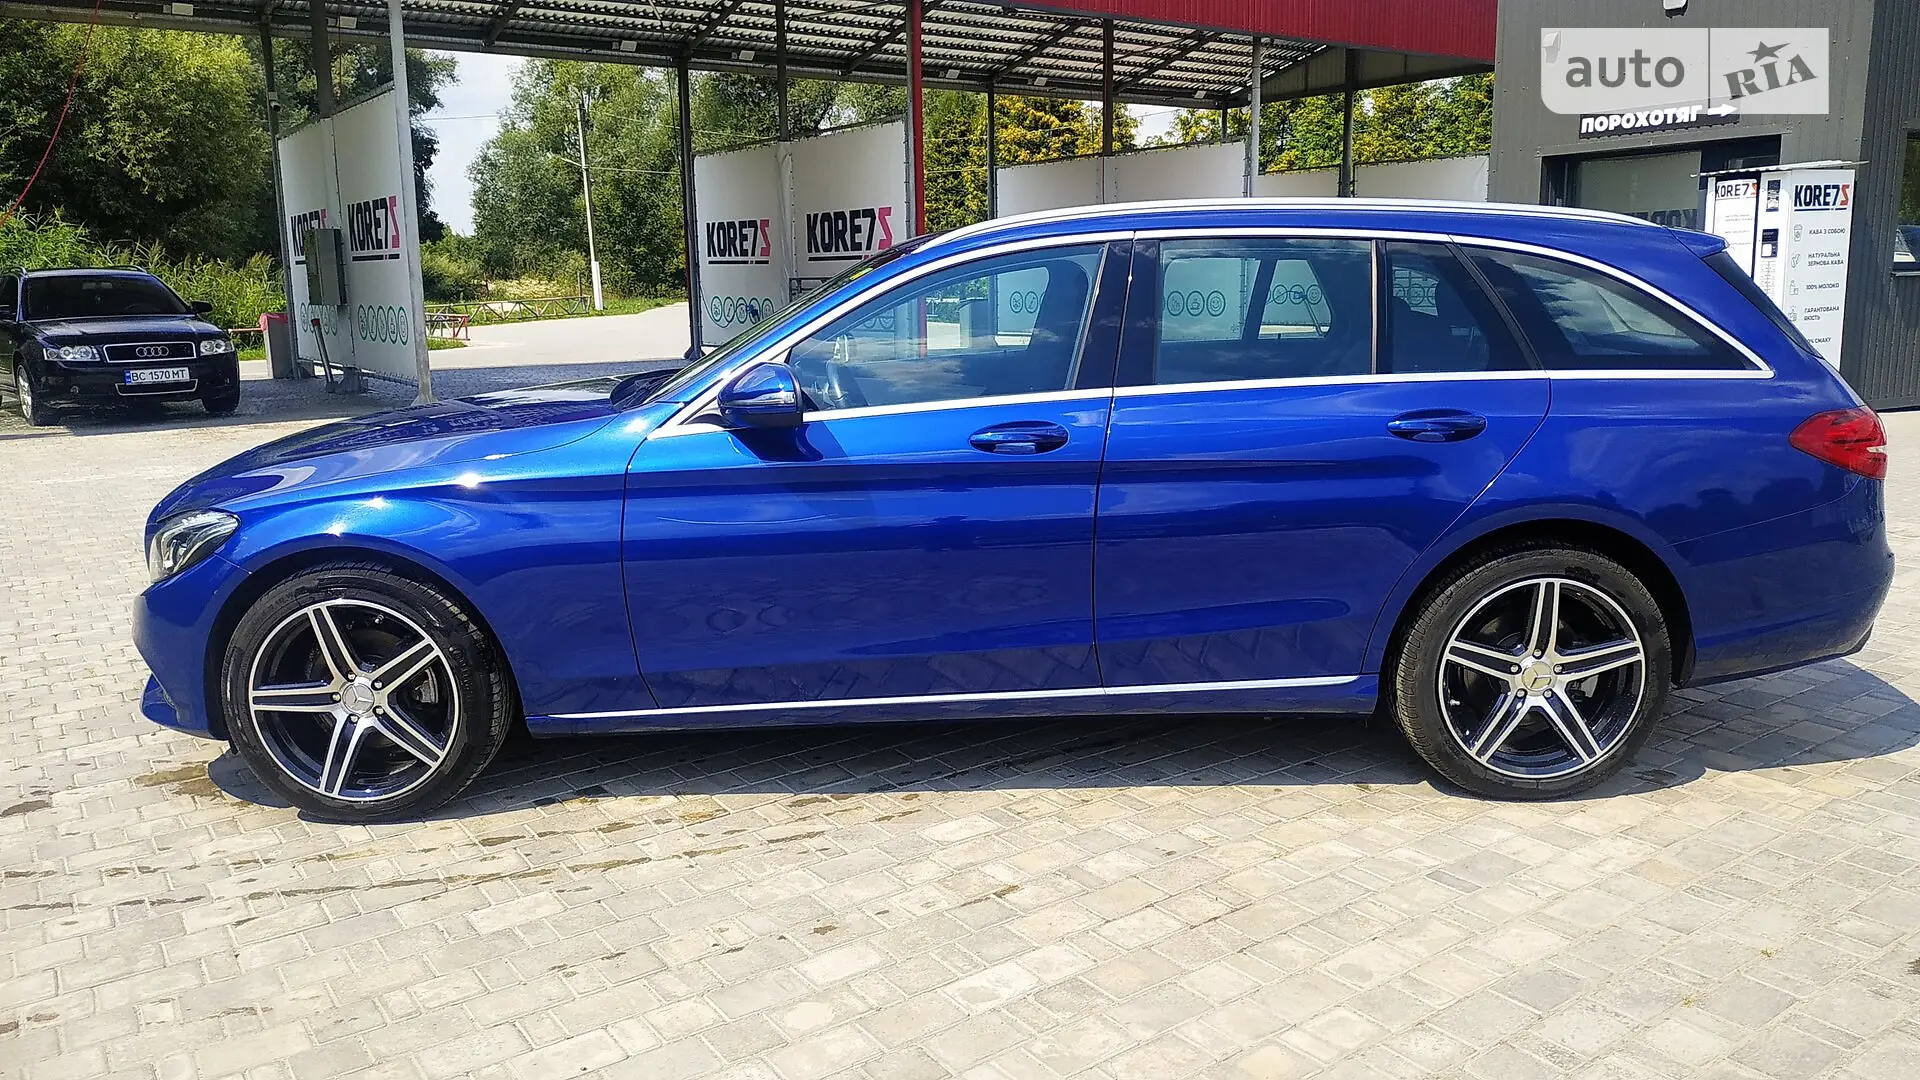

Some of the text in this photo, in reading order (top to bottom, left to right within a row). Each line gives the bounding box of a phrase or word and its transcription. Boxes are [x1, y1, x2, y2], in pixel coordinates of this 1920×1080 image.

[1580, 105, 1703, 134] ПОРОХОТЯГ
[131, 372, 146, 382] BC
[148, 370, 171, 380] 1570
[171, 369, 186, 379] MT
